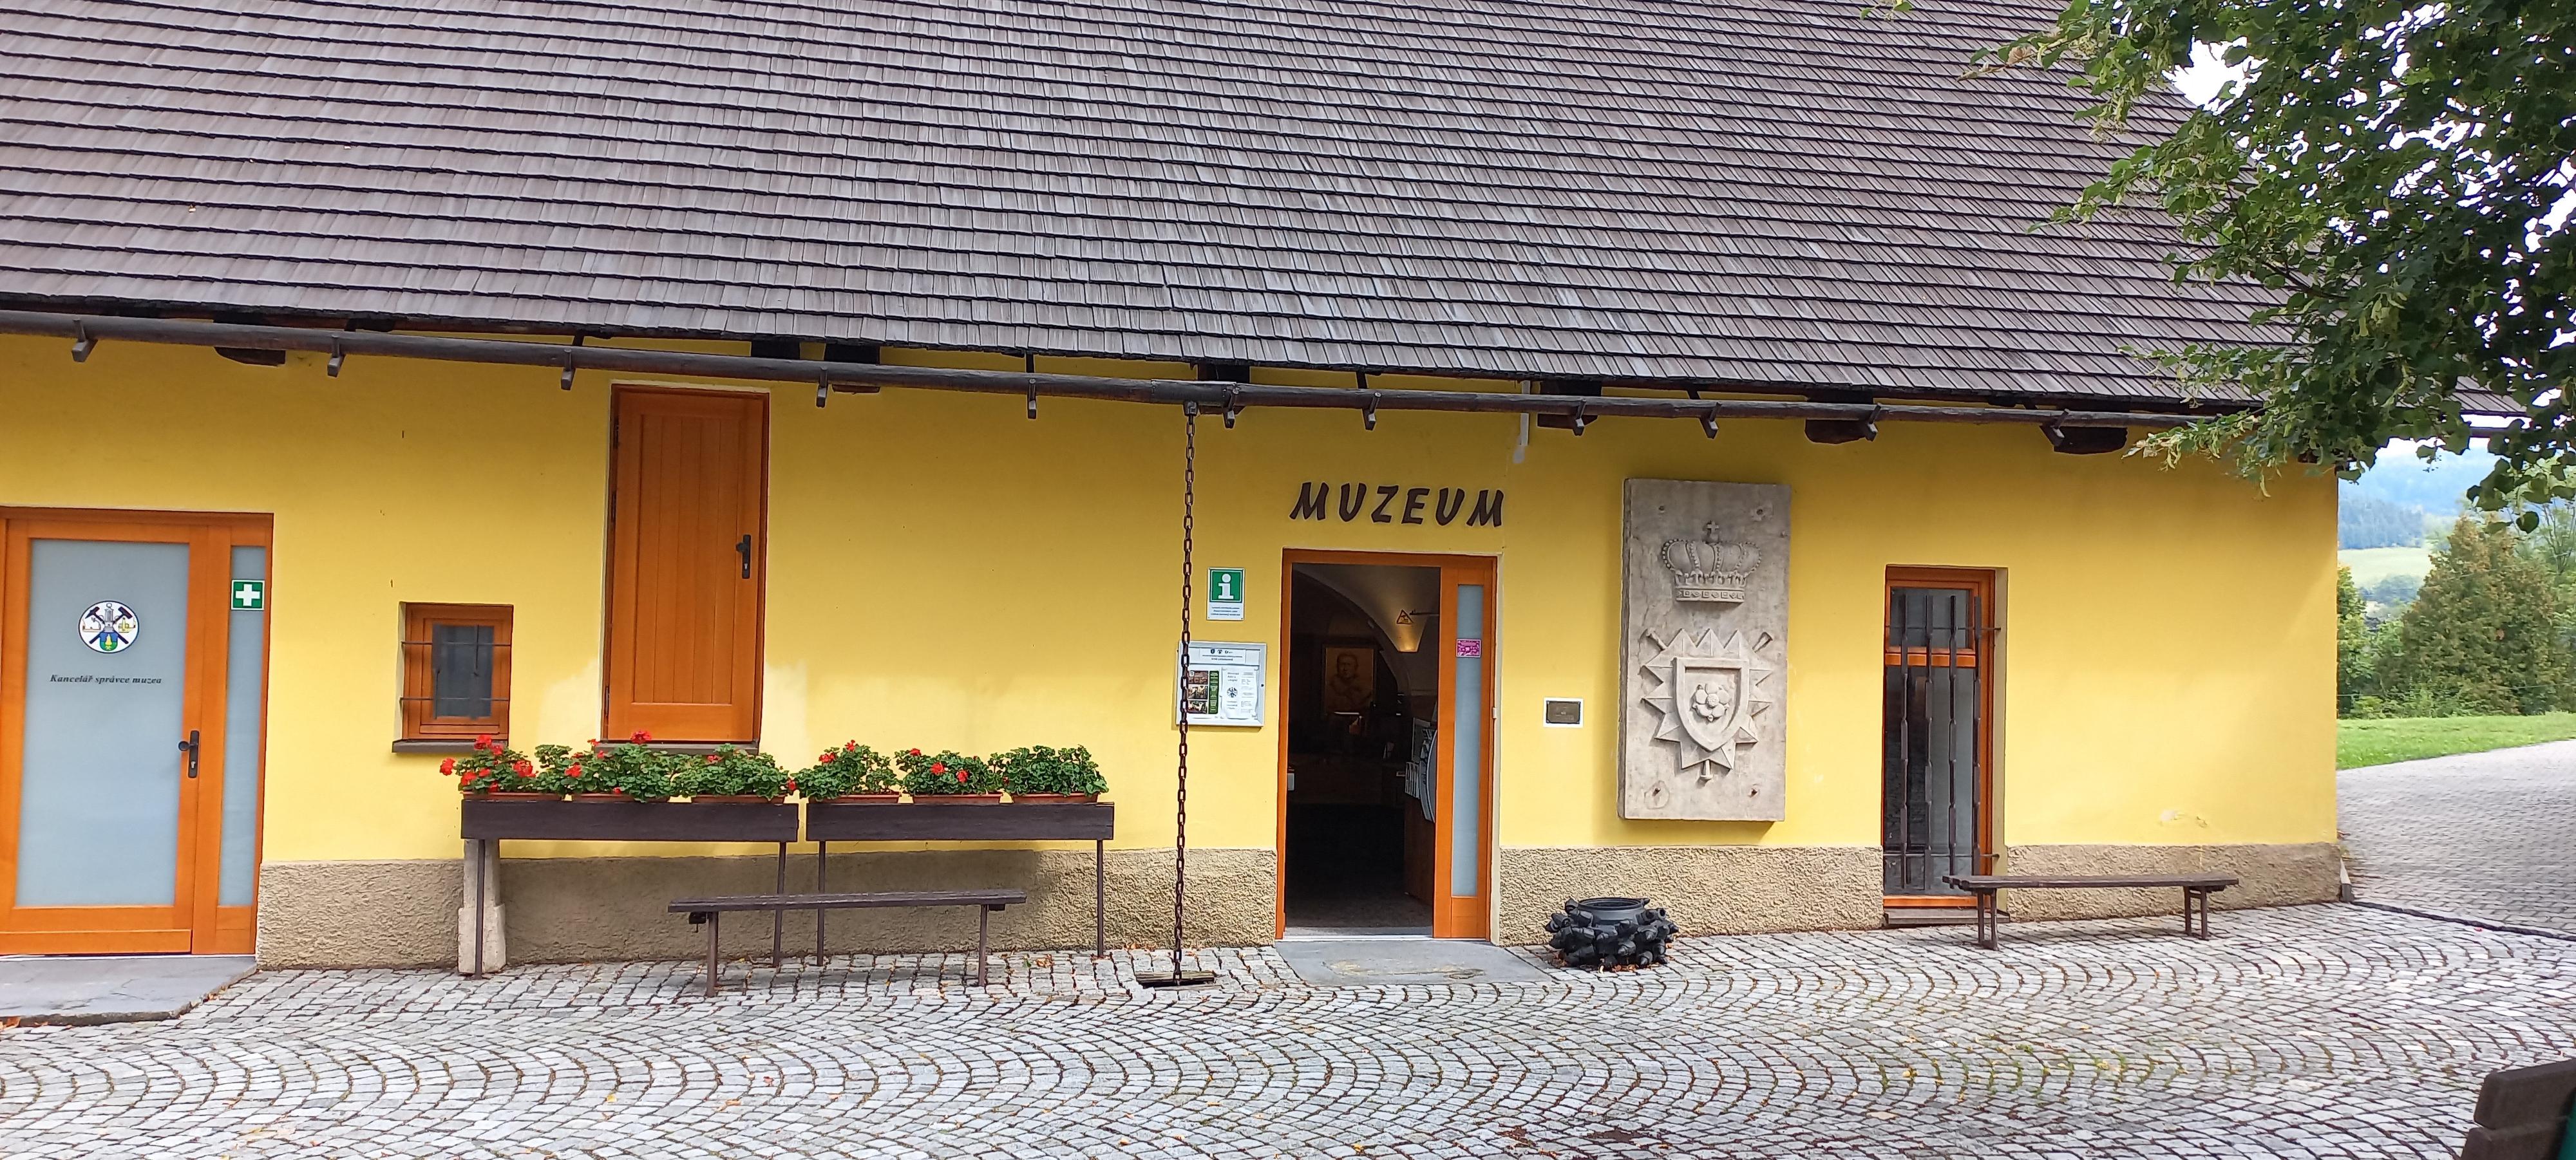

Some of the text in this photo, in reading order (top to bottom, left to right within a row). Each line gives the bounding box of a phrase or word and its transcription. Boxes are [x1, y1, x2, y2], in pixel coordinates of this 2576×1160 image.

[1289, 482, 1504, 528] MUZEUM
[50, 674, 93, 683] Kancelář
[95, 675, 130, 684] správce
